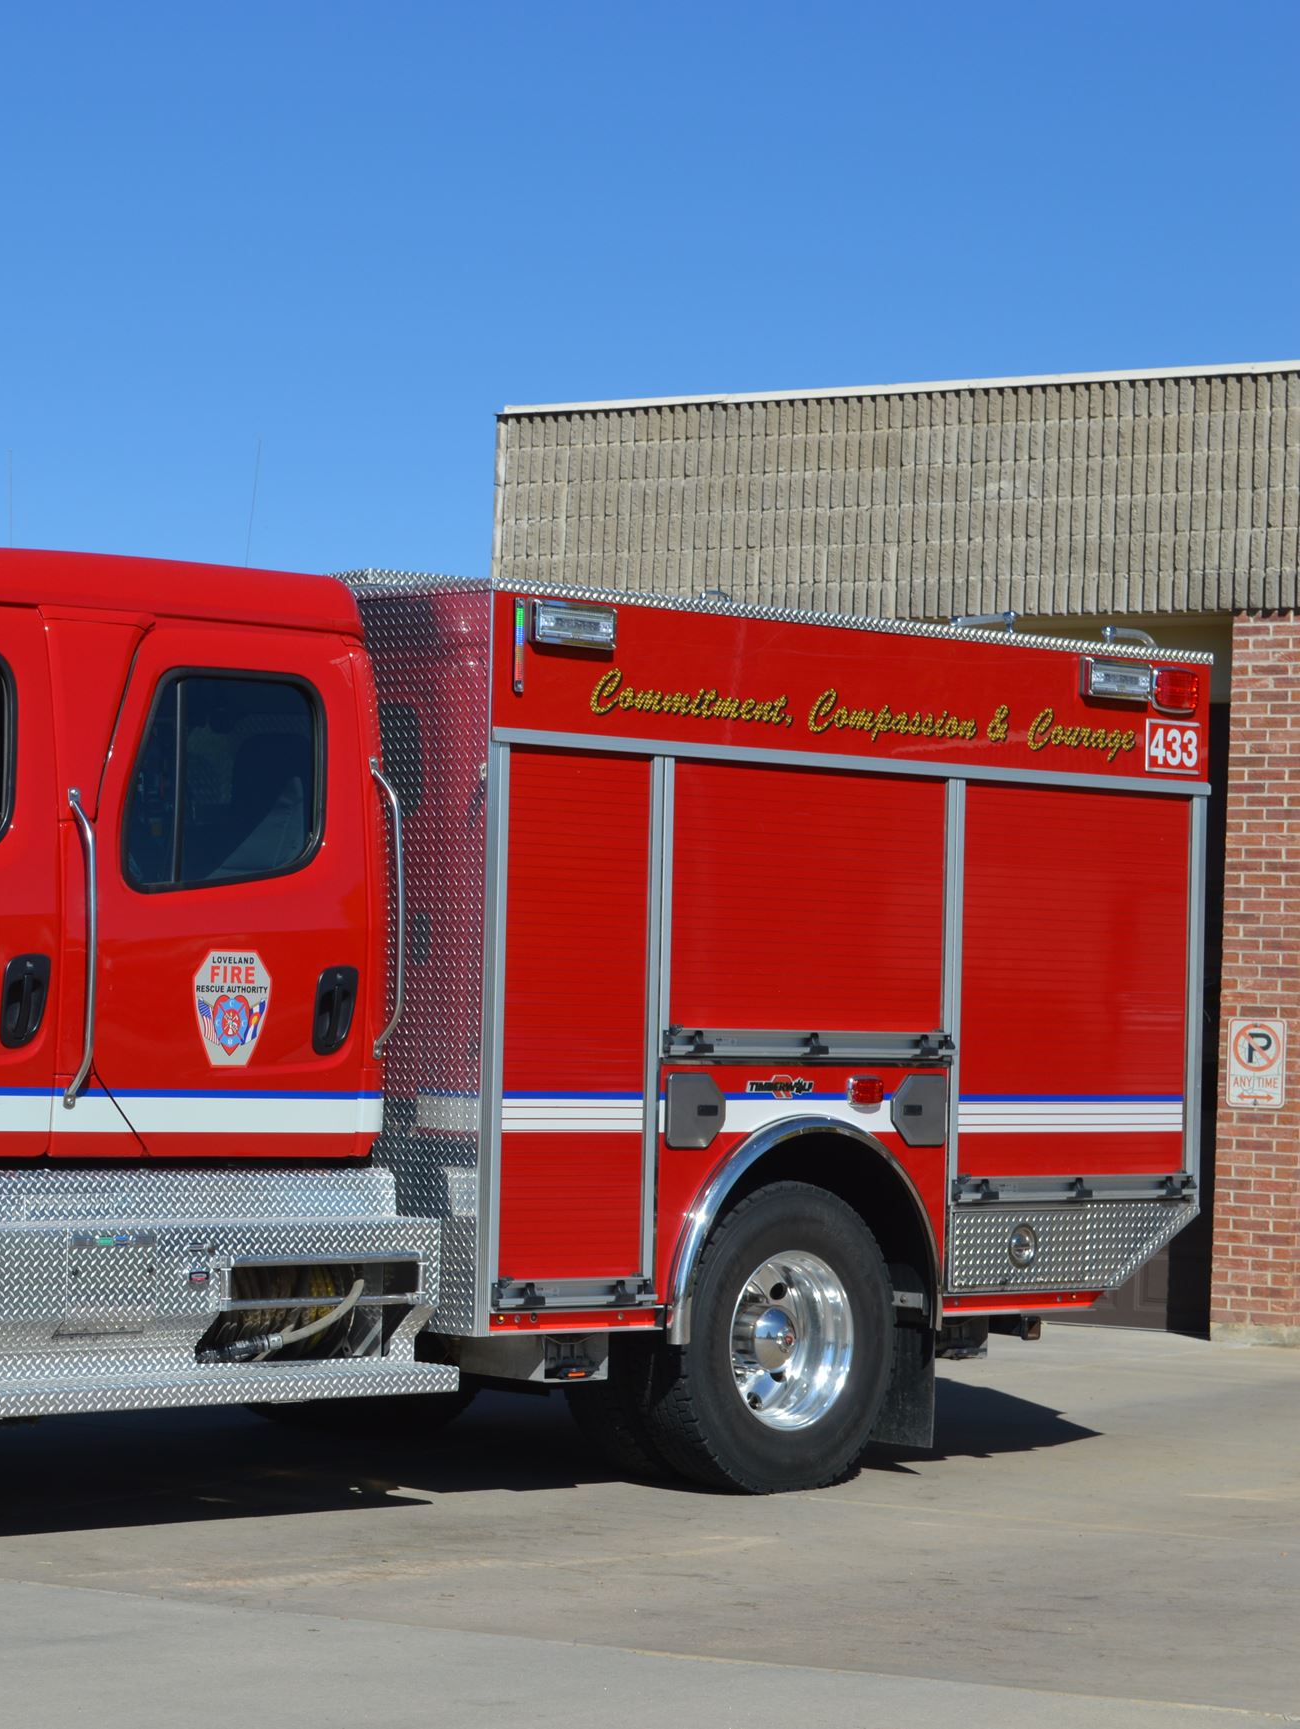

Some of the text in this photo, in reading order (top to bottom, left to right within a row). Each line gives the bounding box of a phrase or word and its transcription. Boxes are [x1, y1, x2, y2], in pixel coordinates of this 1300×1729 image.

[590, 668, 1135, 762] Commitment, Compassion & Courage
[1149, 727, 1199, 768] 433
[212, 956, 255, 964] LOVELAND
[210, 966, 255, 984] FIRE
[196, 985, 268, 993] RESCUE AUTHORITY
[1233, 1076, 1279, 1089] ANY TIME
